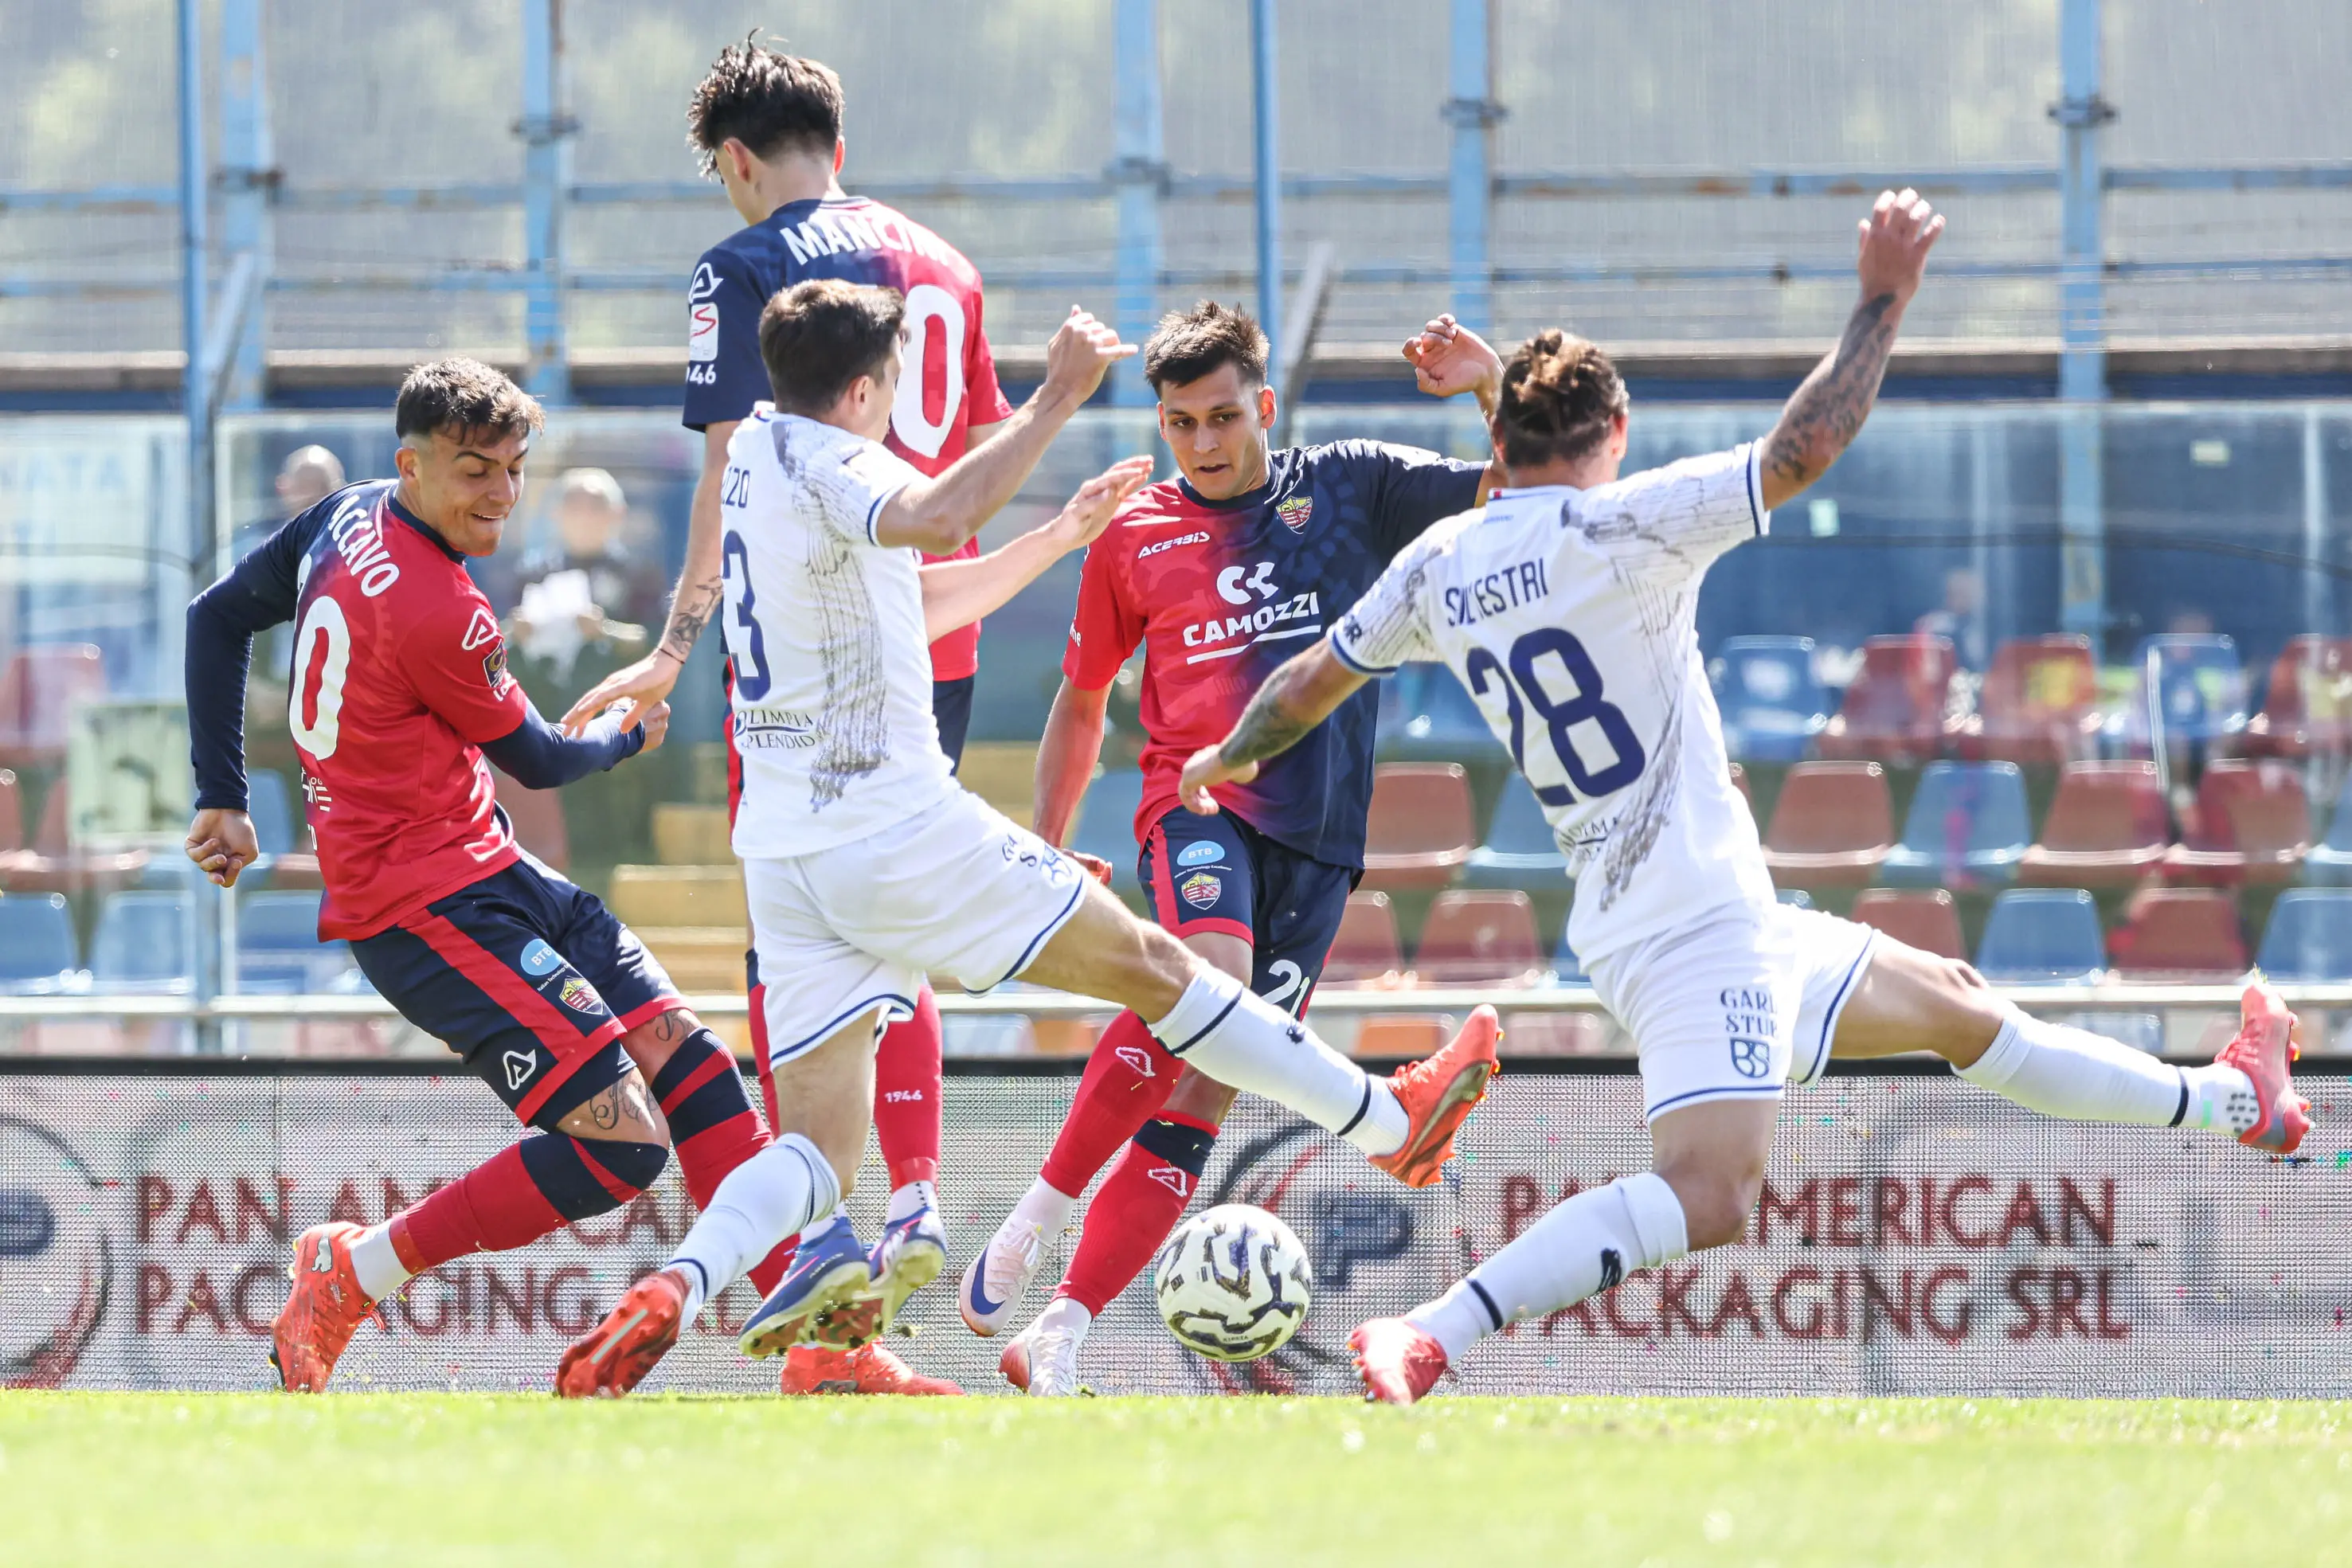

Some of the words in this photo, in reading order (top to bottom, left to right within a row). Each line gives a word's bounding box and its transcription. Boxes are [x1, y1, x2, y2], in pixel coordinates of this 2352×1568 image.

[780, 213, 949, 265] MANCI
[686, 364, 717, 385] 46
[890, 284, 965, 459] 0
[1183, 592, 1321, 647] CAMOZZI
[1466, 628, 1646, 807] 28
[1188, 847, 1213, 859] BTB
[530, 947, 553, 966] BTB
[1260, 959, 1311, 1019] 21
[884, 1089, 923, 1103] 1946
[136, 1175, 293, 1244] PAN
[1740, 1174, 2116, 1246] MERICAN
[136, 1262, 604, 1335] PACGING
[1504, 1264, 1972, 1340] ACKAGING
[2007, 1266, 2131, 1340] SRL
